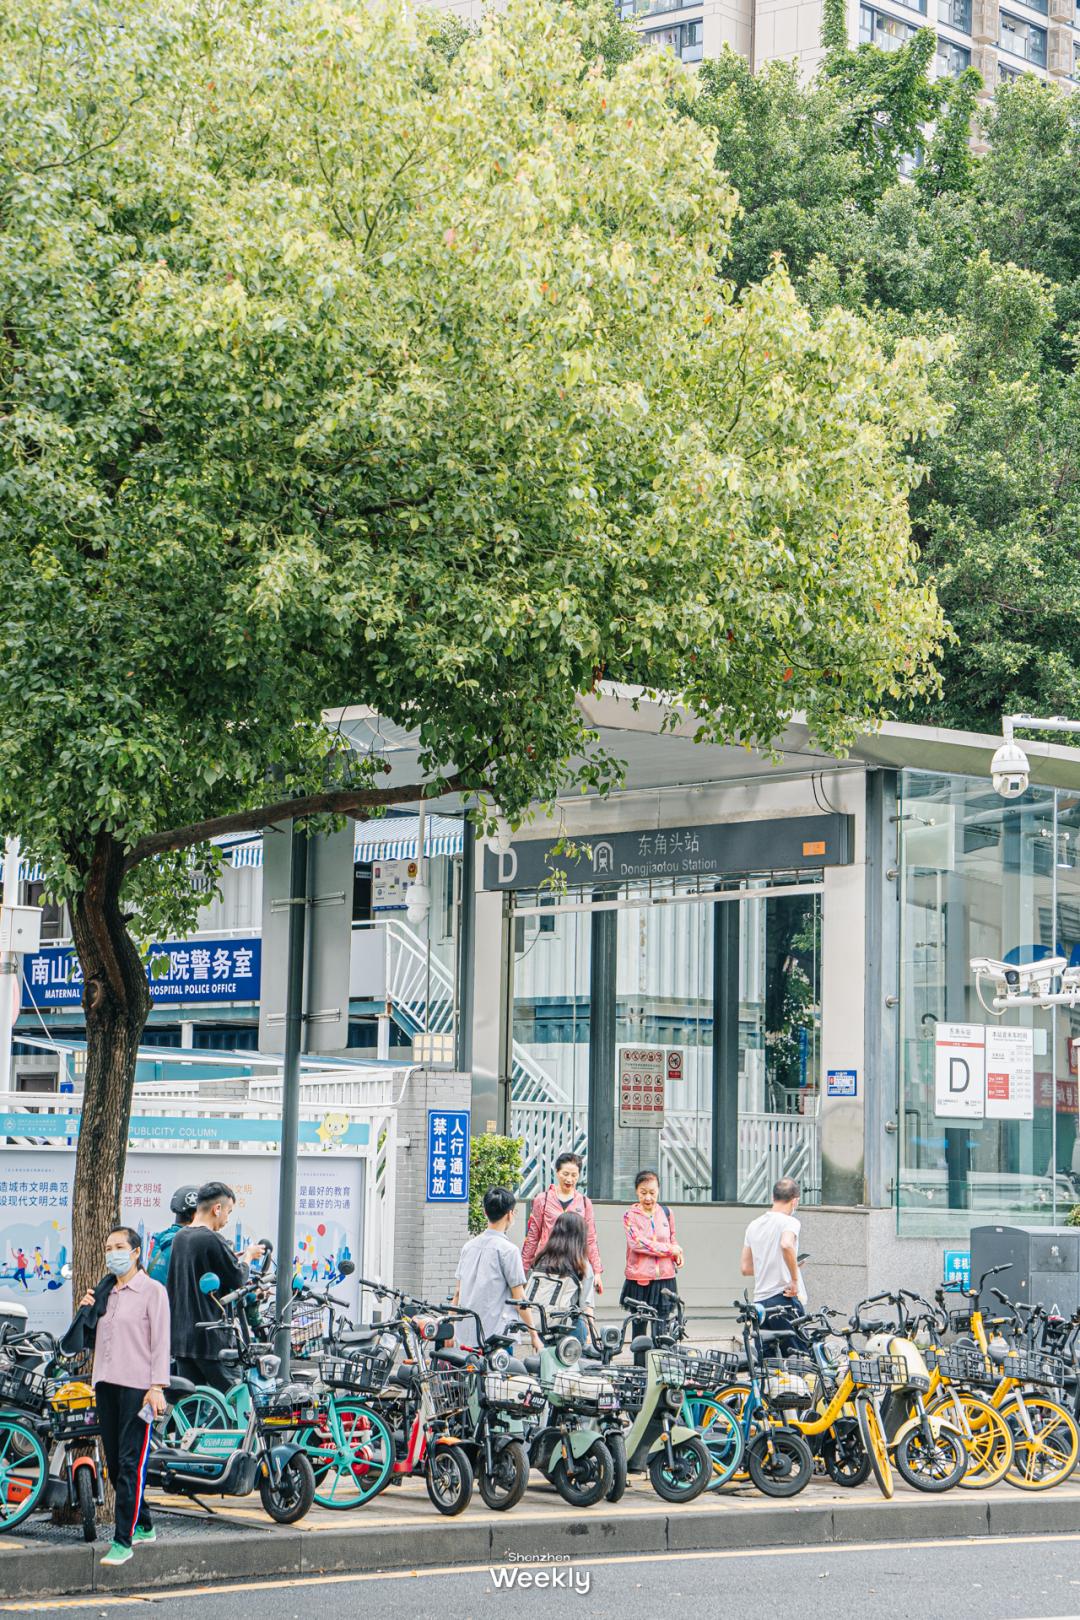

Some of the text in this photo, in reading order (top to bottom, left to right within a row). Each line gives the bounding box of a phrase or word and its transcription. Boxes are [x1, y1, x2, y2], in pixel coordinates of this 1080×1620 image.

[638, 831, 699, 856] 东角头站
[498, 847, 518, 884] D
[620, 857, 718, 877] Dongjiaotou Station
[45, 982, 237, 998] MATERNAL HOSPITAL POLICE OFFICE
[949, 1057, 970, 1093] D
[129, 1127, 218, 1137] PUBLICITY COLUMN
[432, 1117, 447, 1195] 禁止停放
[449, 1118, 464, 1195] 人行通道
[300, 1185, 351, 1197] 是最好的教育
[299, 1198, 351, 1210] 是最好的沟通
